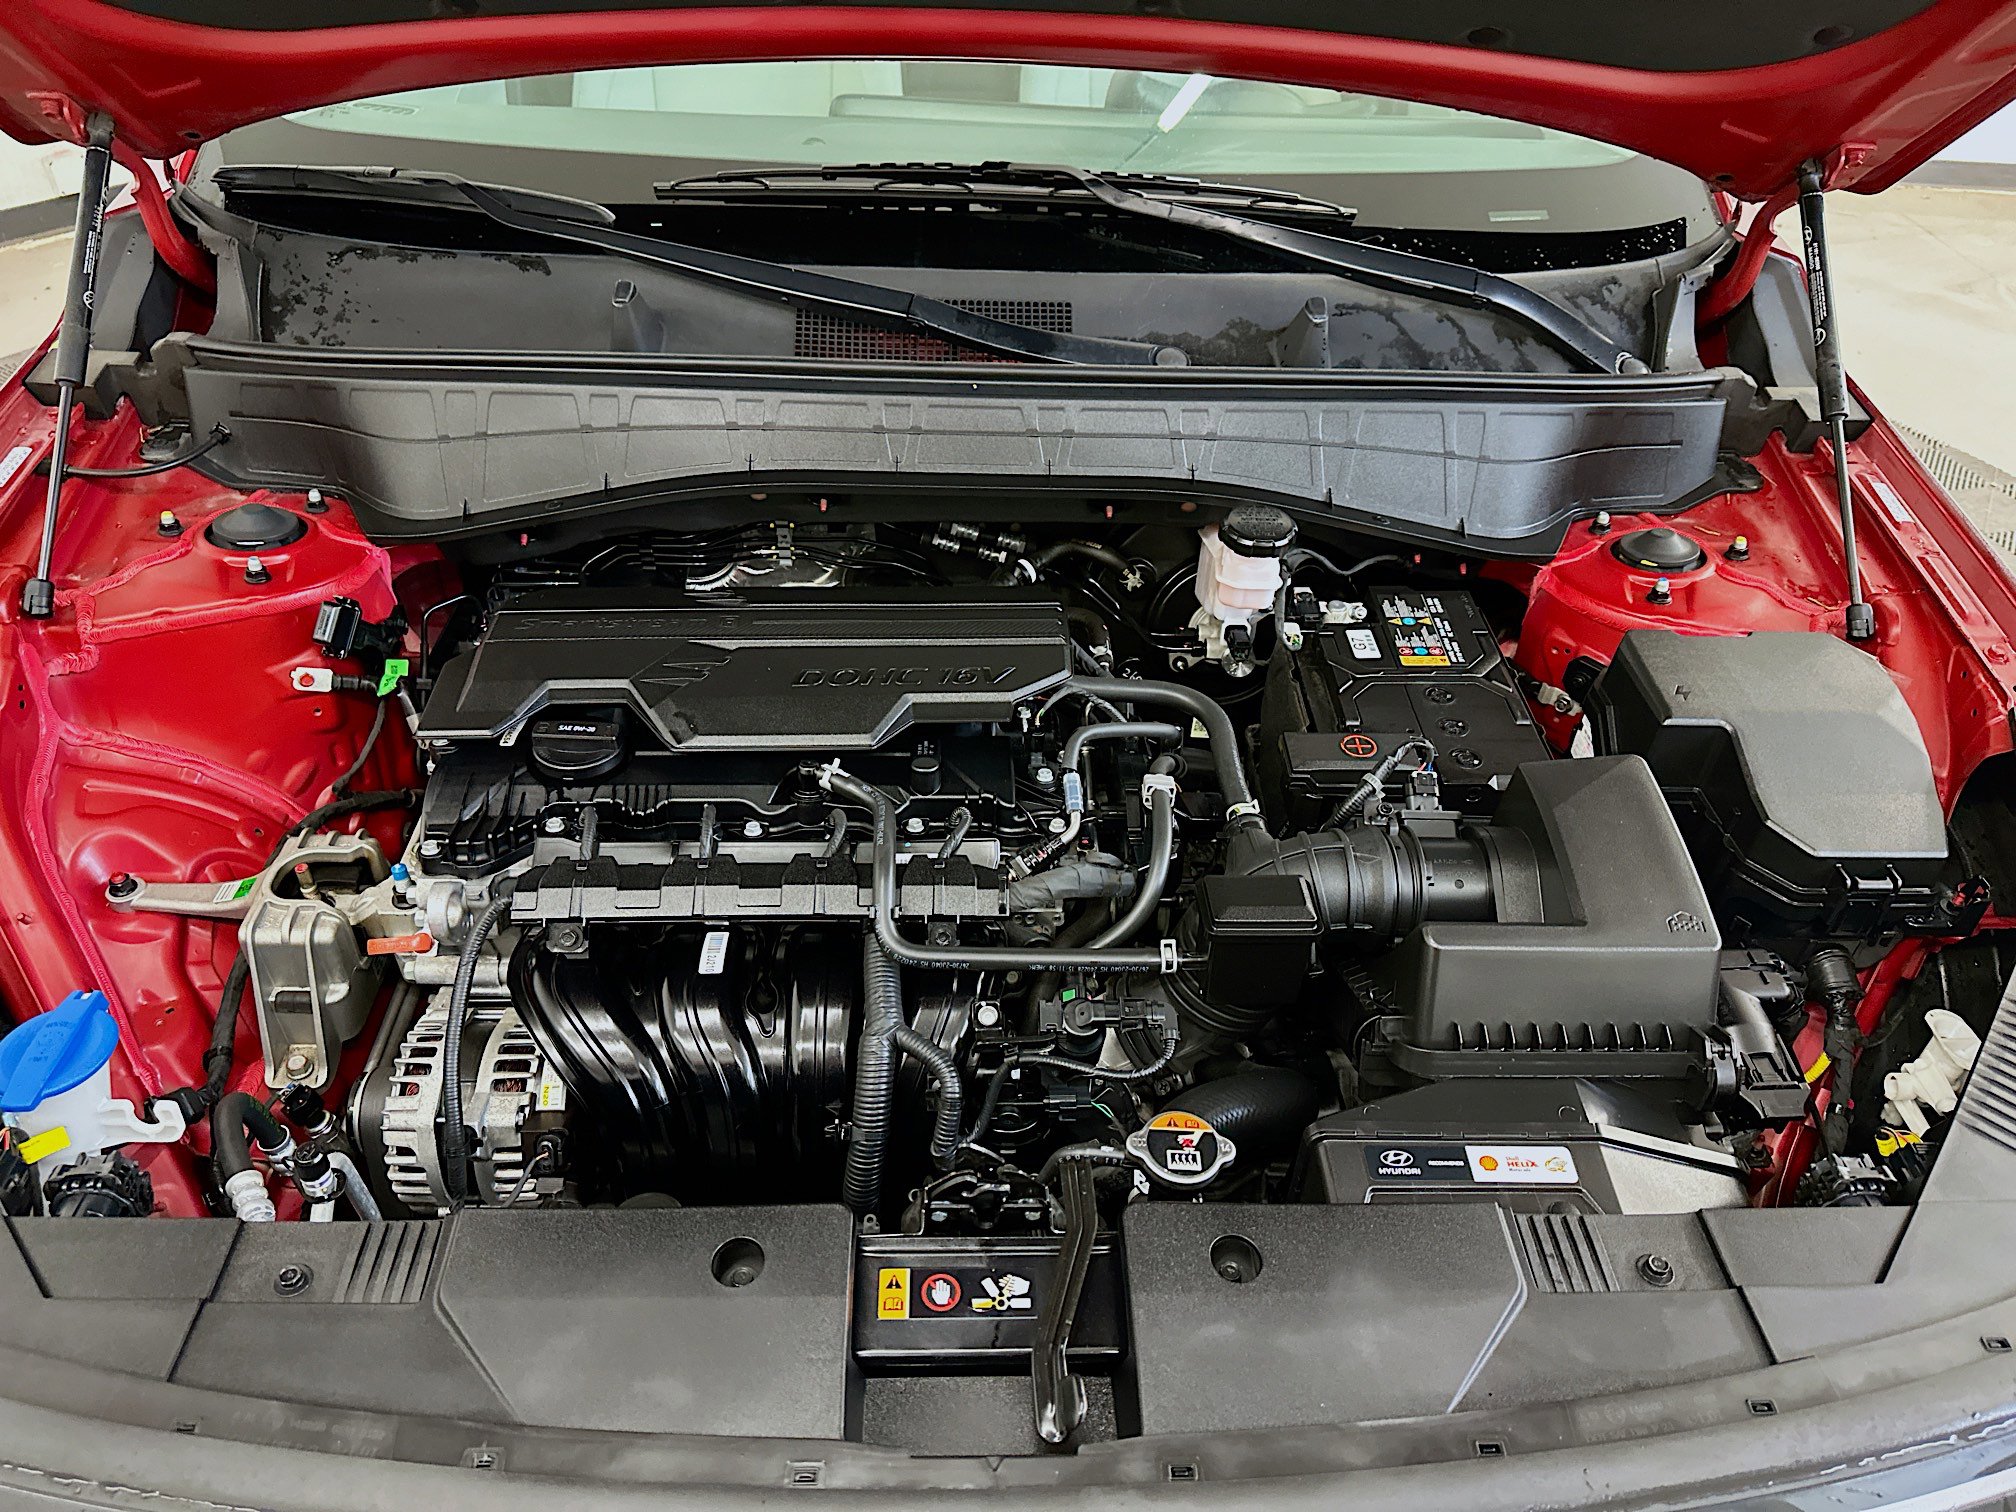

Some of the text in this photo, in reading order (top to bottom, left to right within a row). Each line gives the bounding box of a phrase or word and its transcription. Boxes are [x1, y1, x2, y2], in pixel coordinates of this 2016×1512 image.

[791, 666, 1017, 687] DOHC 16V
[557, 724, 572, 732] SAE
[1506, 1160, 1540, 1168] HELIX
[1378, 1166, 1422, 1176] HYUNDAI
